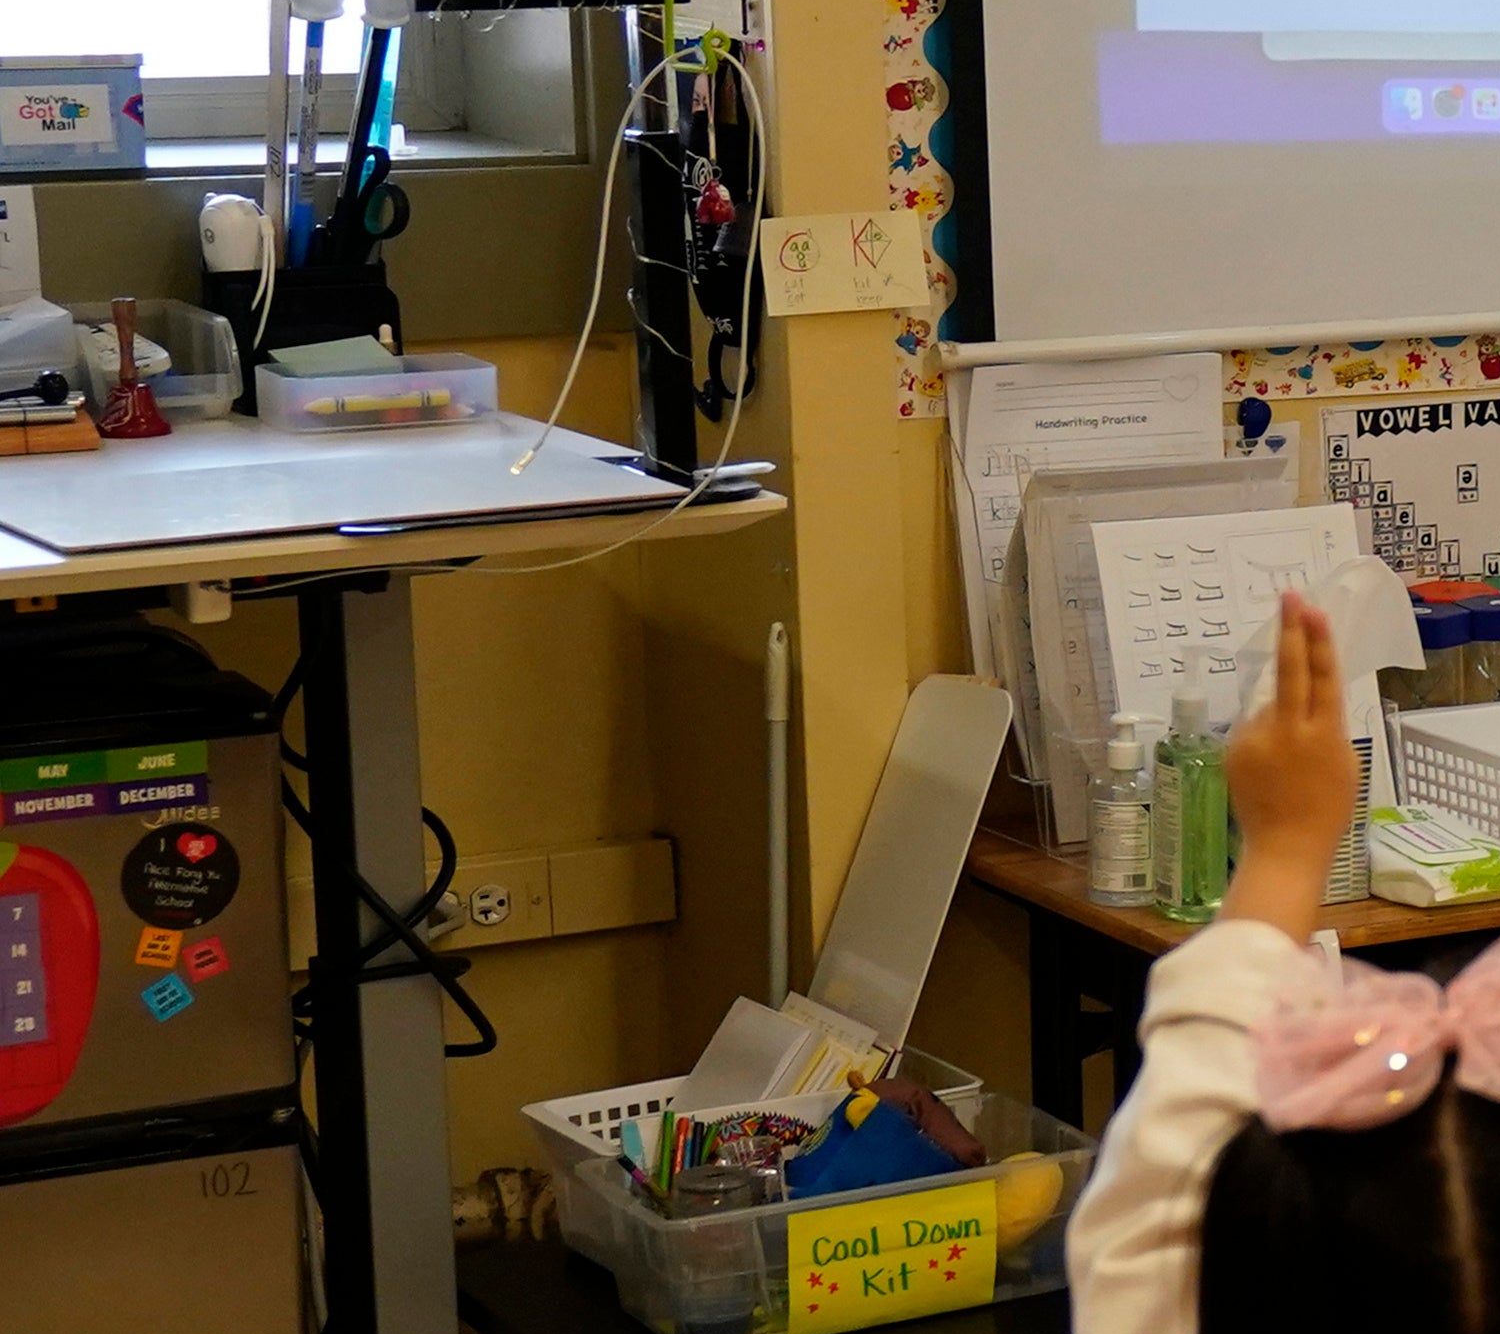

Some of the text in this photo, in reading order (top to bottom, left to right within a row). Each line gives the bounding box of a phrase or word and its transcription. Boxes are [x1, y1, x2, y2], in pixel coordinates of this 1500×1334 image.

[19, 104, 55, 120] Got
[42, 118, 76, 132] Mail
[1035, 413, 1148, 431] Handwriting Practice
[1360, 404, 1451, 431] VOWEL
[138, 753, 176, 769] JUNE
[38, 764, 69, 779] MAY
[119, 783, 195, 805] DECEMBER
[15, 793, 95, 815] NOVEMBER
[13, 907, 23, 921] 7
[11, 943, 27, 958] 14
[17, 980, 32, 994] 21
[202, 1162, 258, 1199] 102
[812, 1215, 983, 1266] Cool Down
[863, 1264, 918, 1298] Kit
